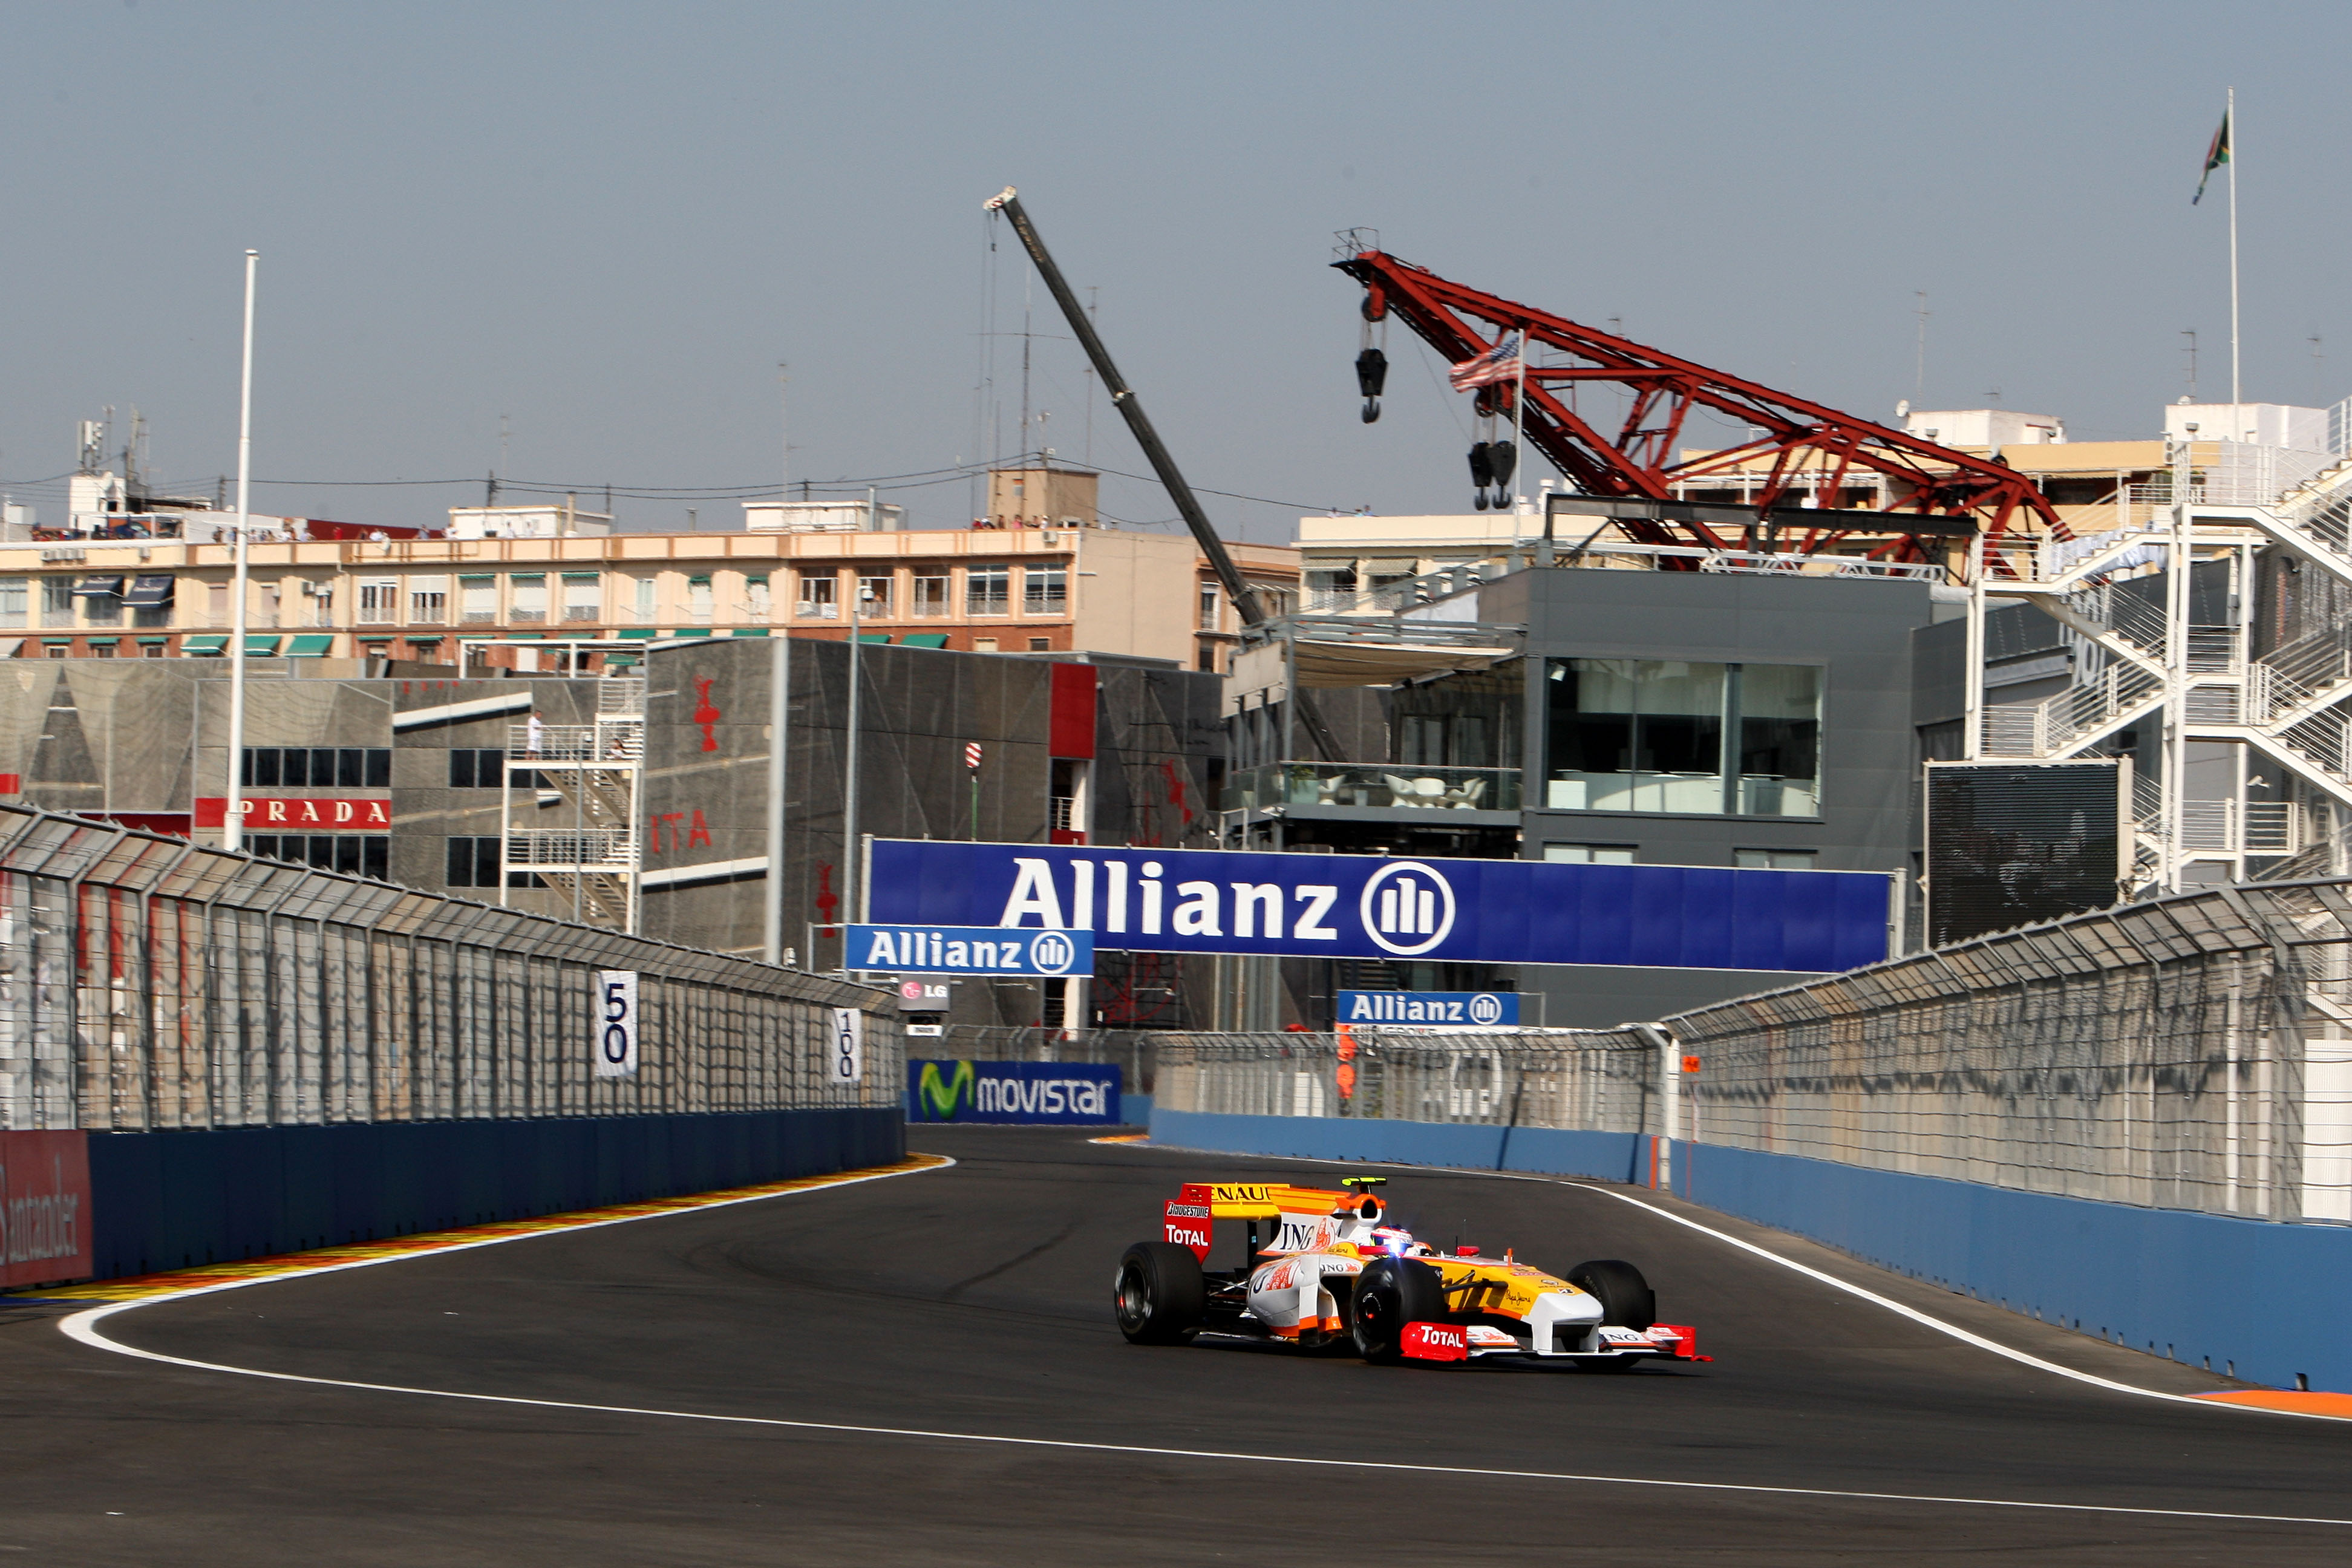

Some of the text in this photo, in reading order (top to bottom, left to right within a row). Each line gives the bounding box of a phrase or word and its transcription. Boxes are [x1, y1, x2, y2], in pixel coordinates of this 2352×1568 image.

[240, 800, 387, 823] PRADA
[650, 809, 712, 852] ITA
[1000, 857, 1338, 940] Allianz
[866, 930, 1022, 969] Allianz
[924, 984, 948, 998] LG
[1350, 995, 1464, 1021] Allianz
[1279, 1223, 1315, 1250] ING
